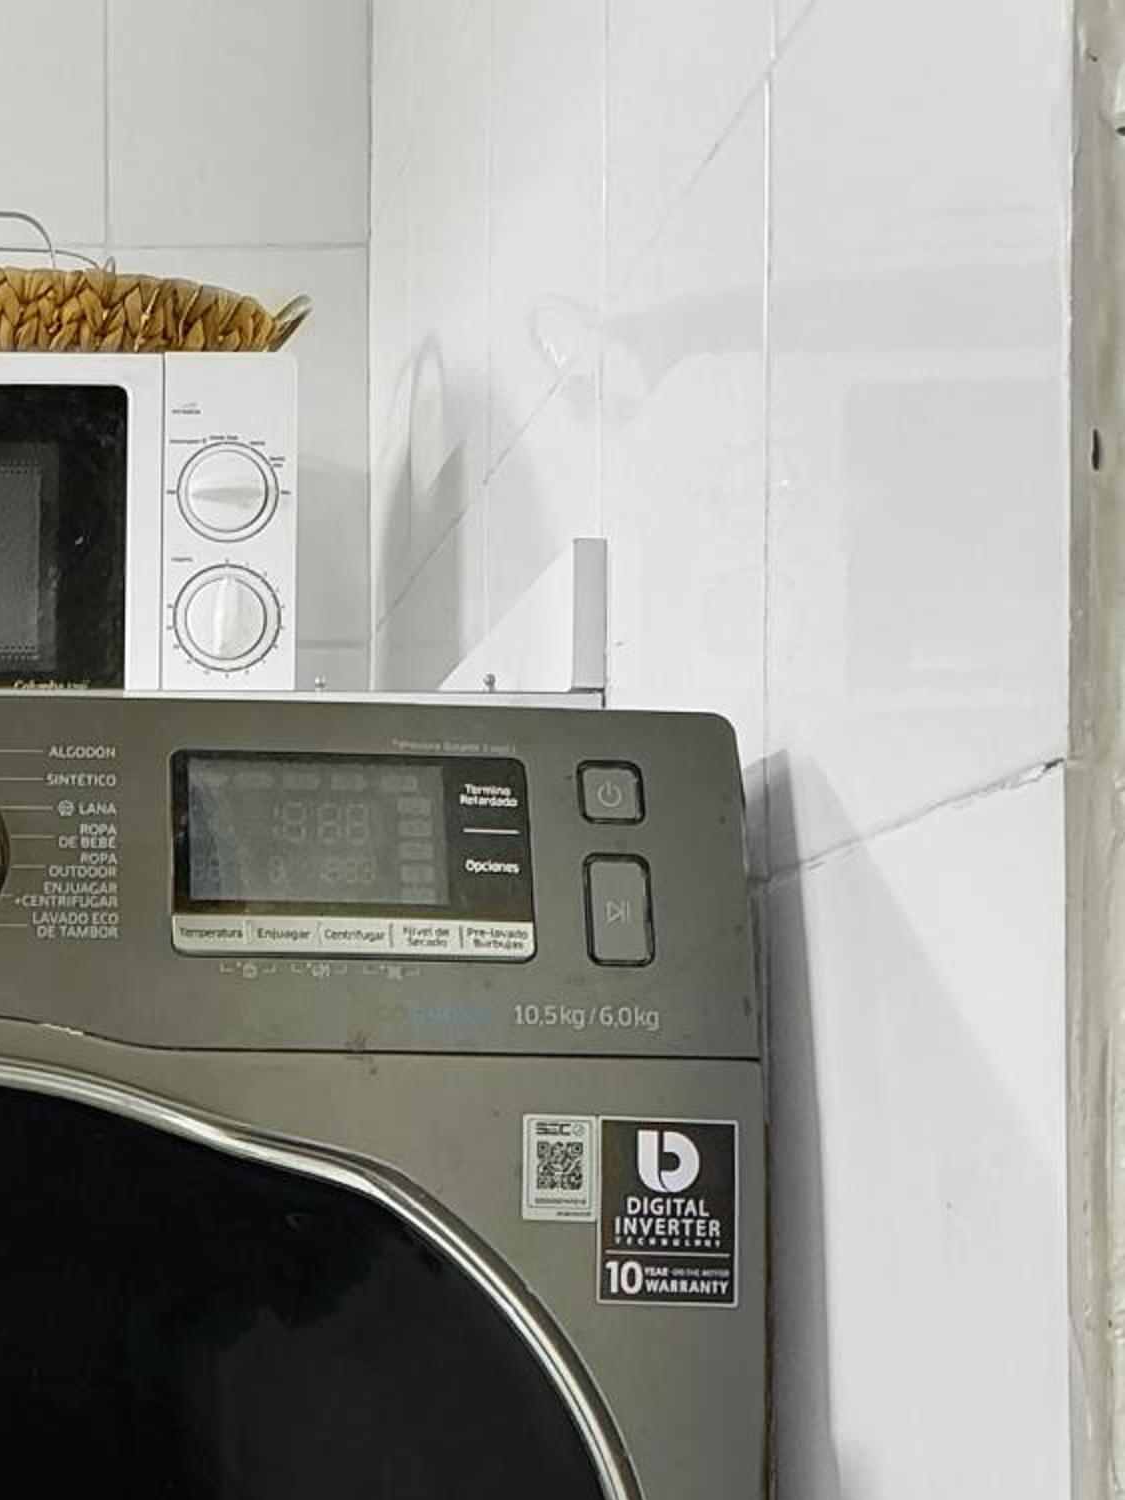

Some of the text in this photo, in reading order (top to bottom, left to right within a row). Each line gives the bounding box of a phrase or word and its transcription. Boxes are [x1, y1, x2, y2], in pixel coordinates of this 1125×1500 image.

[459, 794, 519, 807] Retardado
[78, 801, 117, 816] LANA
[79, 823, 118, 836] ROPA
[58, 835, 77, 849] DE
[79, 852, 118, 865] ROPA
[48, 864, 117, 878] OUTDOOR
[465, 858, 520, 875] Opciones
[43, 881, 118, 896] ENJUAGAR
[32, 911, 119, 926] LAVADO ECO
[36, 925, 118, 939] DE TAMBOR
[178, 927, 244, 941] Temperatura
[256, 927, 311, 941] Enjuagar
[324, 928, 385, 944] Centrifugar
[434, 927, 450, 937] de
[466, 927, 530, 940] Pre-lavado
[626, 1197, 710, 1217] DIGITAL
[614, 1216, 721, 1238] INVERTER
[605, 1261, 644, 1295] 10
[644, 1267, 668, 1277] YEAR
[644, 1279, 730, 1295] WARRANTY
